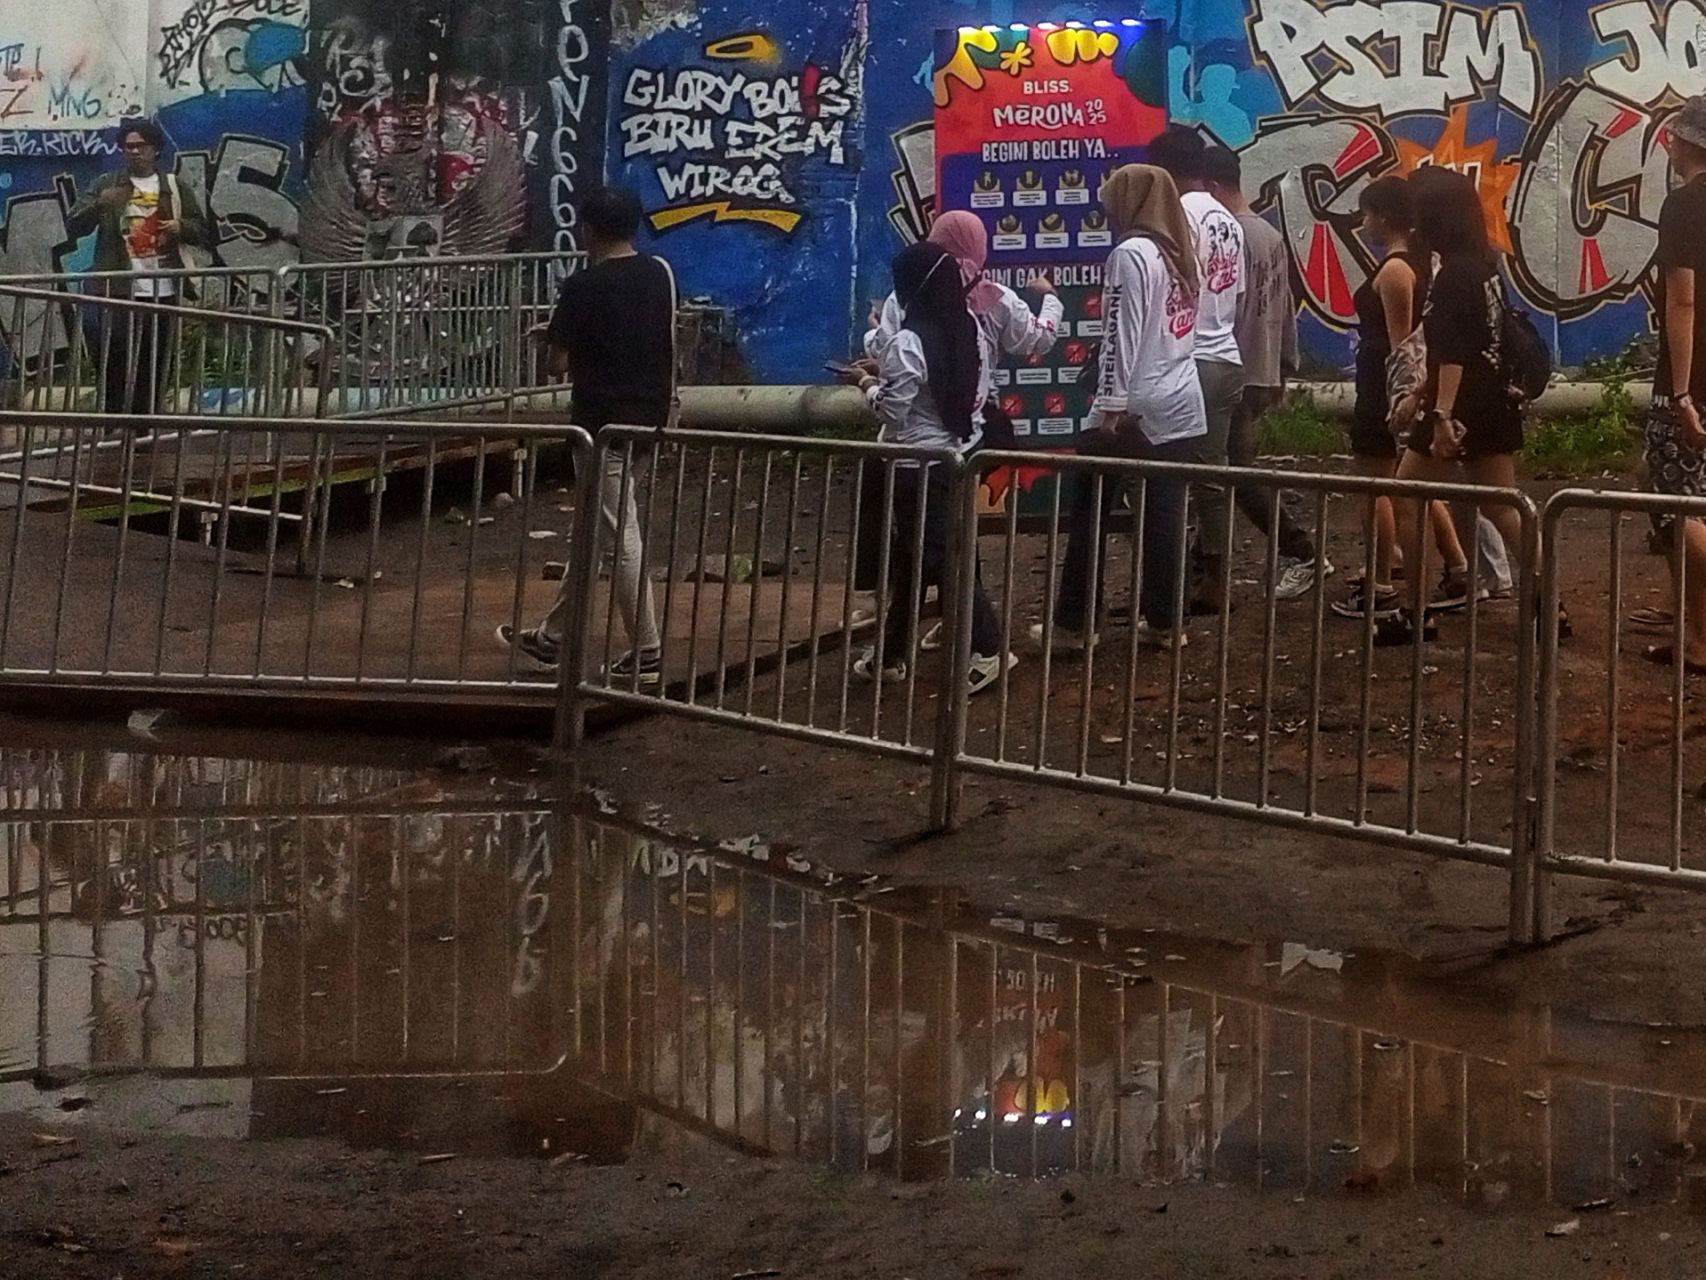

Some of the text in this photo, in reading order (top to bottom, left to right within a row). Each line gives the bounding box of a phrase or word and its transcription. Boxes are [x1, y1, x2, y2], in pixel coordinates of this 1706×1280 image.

[623, 68, 746, 115] GLORY
[1085, 98, 1103, 114] 20
[620, 111, 715, 158] BIRU
[982, 141, 1028, 163] BEGINI
[1032, 139, 1080, 161] BOLEH
[1053, 265, 1101, 287] BOLEH
